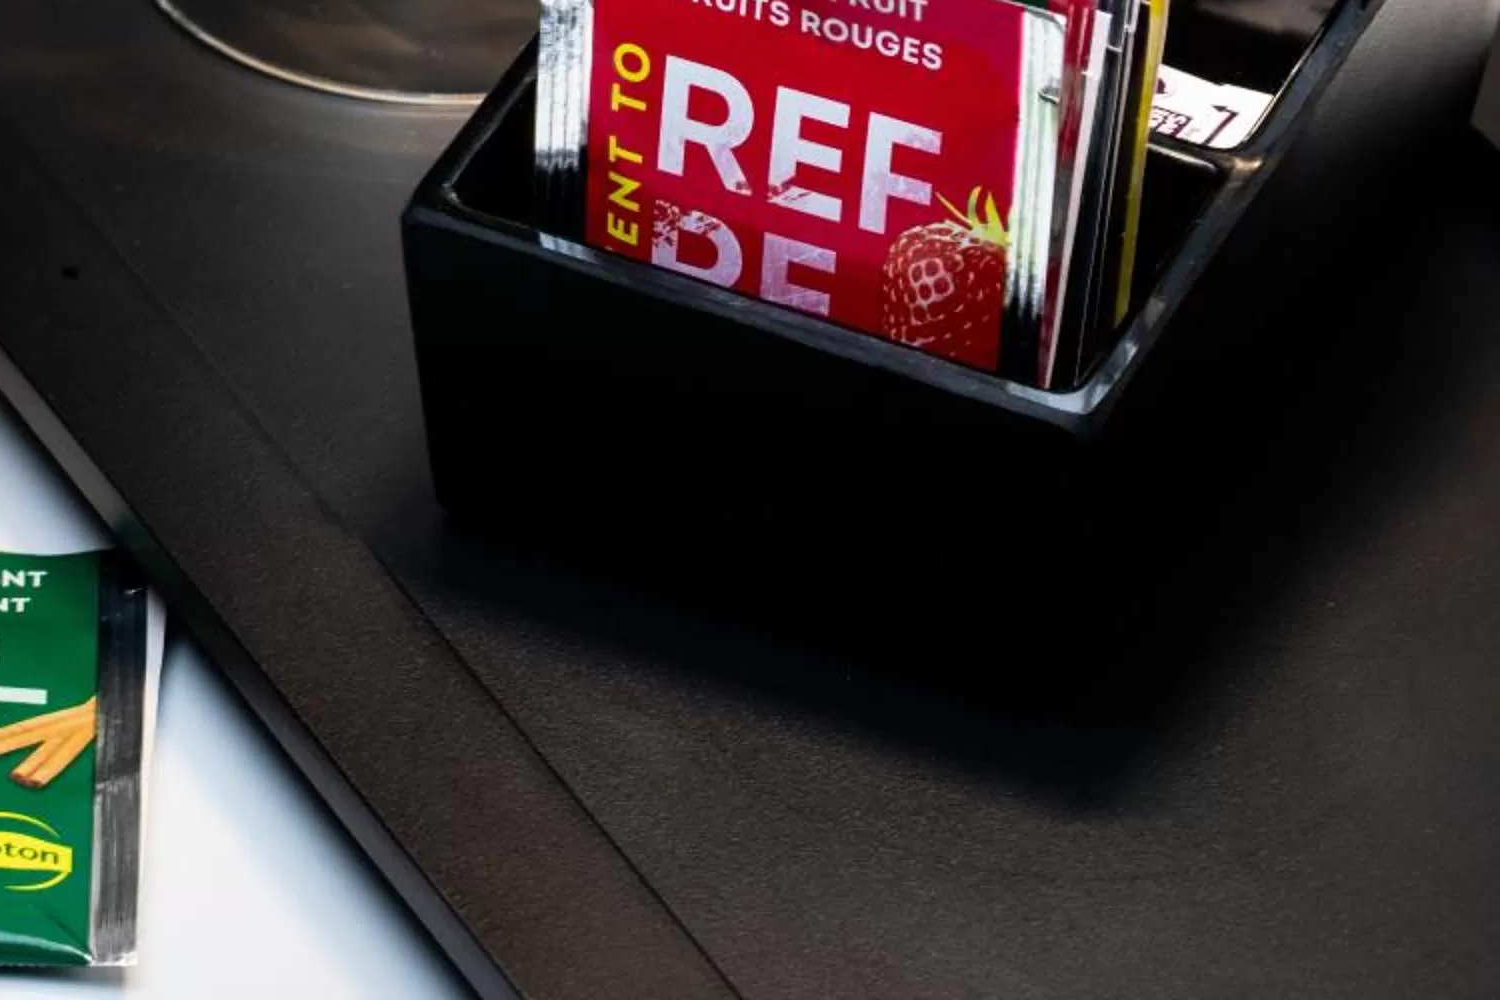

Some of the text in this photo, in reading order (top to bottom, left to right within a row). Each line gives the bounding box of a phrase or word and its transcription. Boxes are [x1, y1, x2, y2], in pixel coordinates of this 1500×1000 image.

[801, 9, 943, 70] ROUGES
[605, 42, 650, 250] ENT TO
[656, 55, 943, 235] REF
